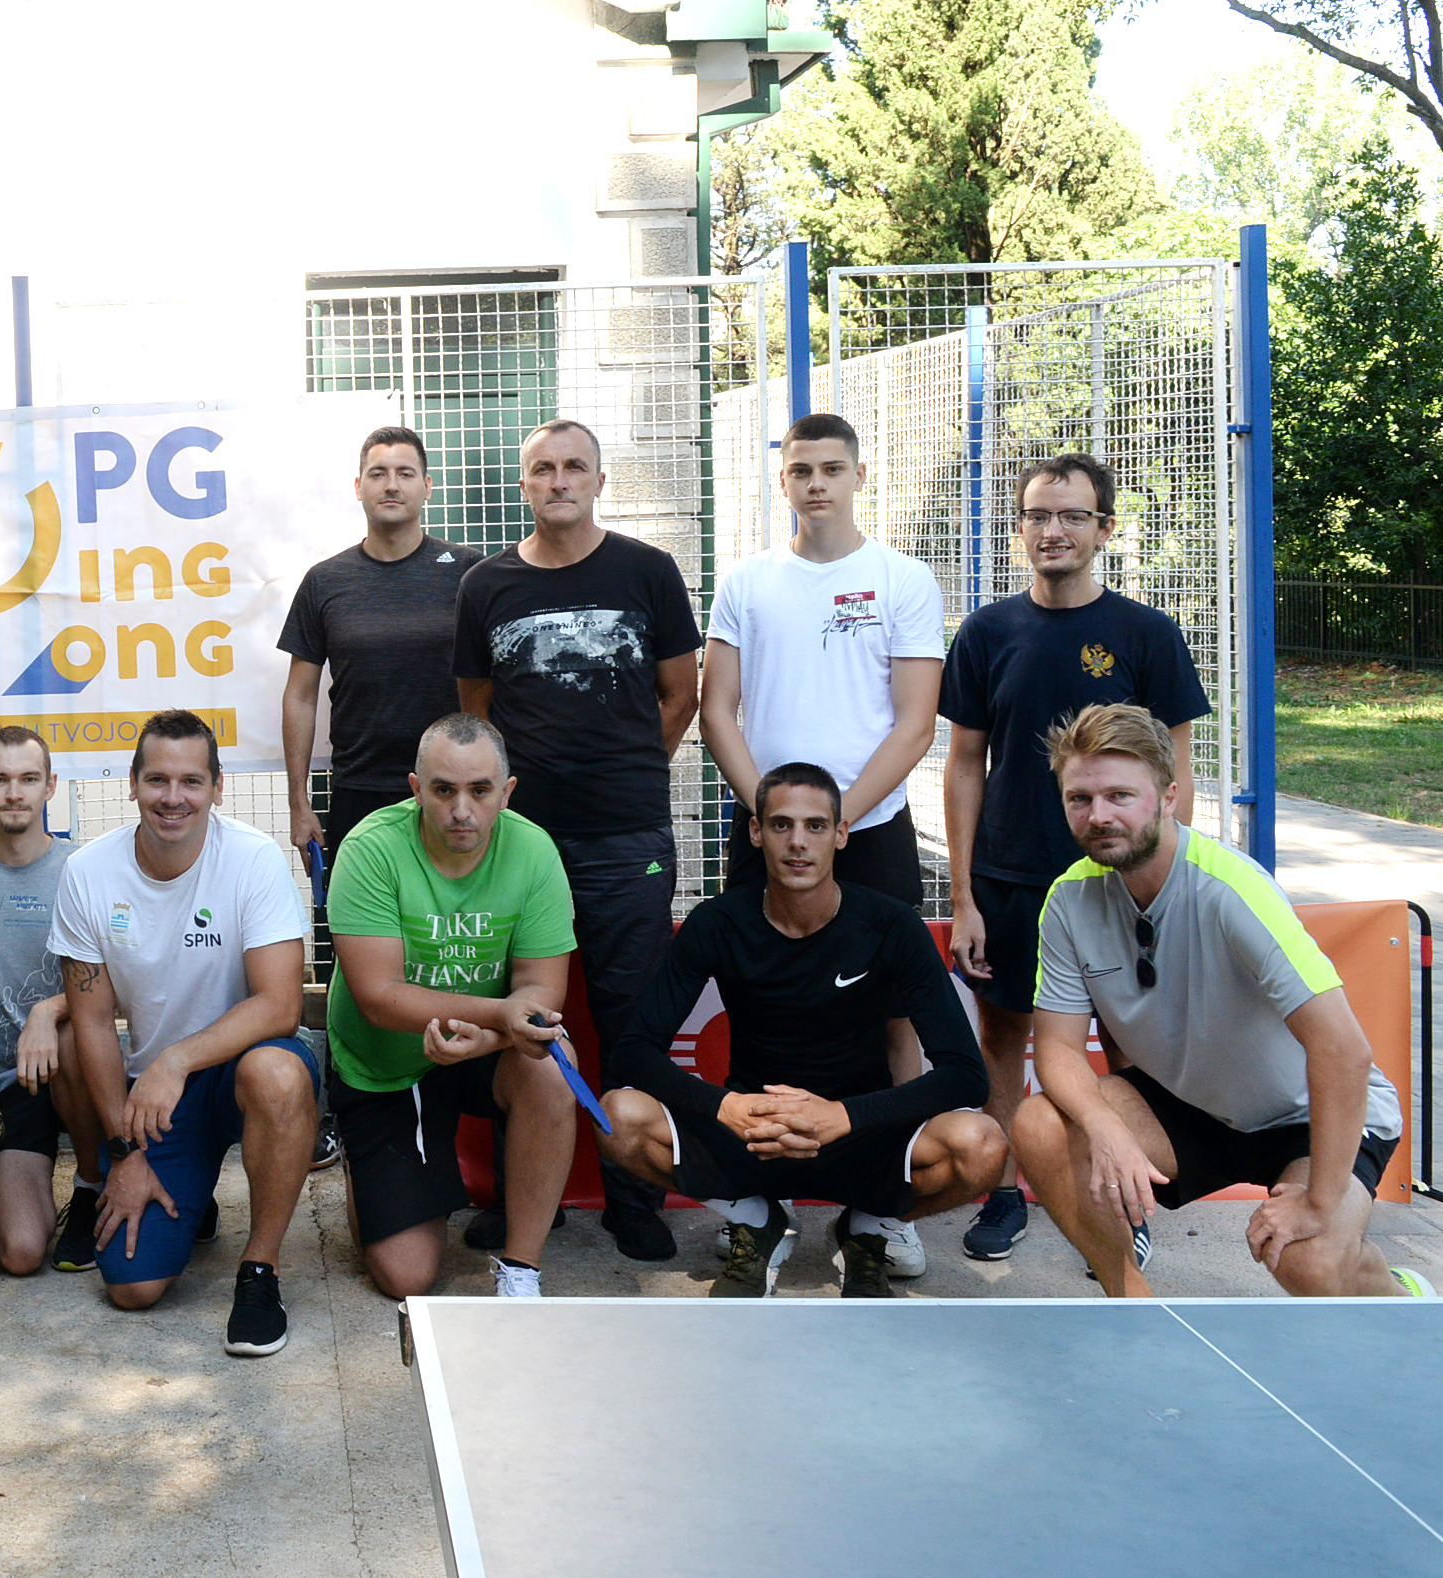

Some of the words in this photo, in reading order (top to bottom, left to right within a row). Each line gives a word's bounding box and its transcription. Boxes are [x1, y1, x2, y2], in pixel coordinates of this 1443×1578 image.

[74, 426, 228, 524] PG
[48, 720, 138, 744] TVOJO
[426, 912, 494, 941] TAKE
[184, 933, 222, 948] SPIN
[438, 944, 477, 960] YOUR
[404, 960, 504, 988] CHANCE
